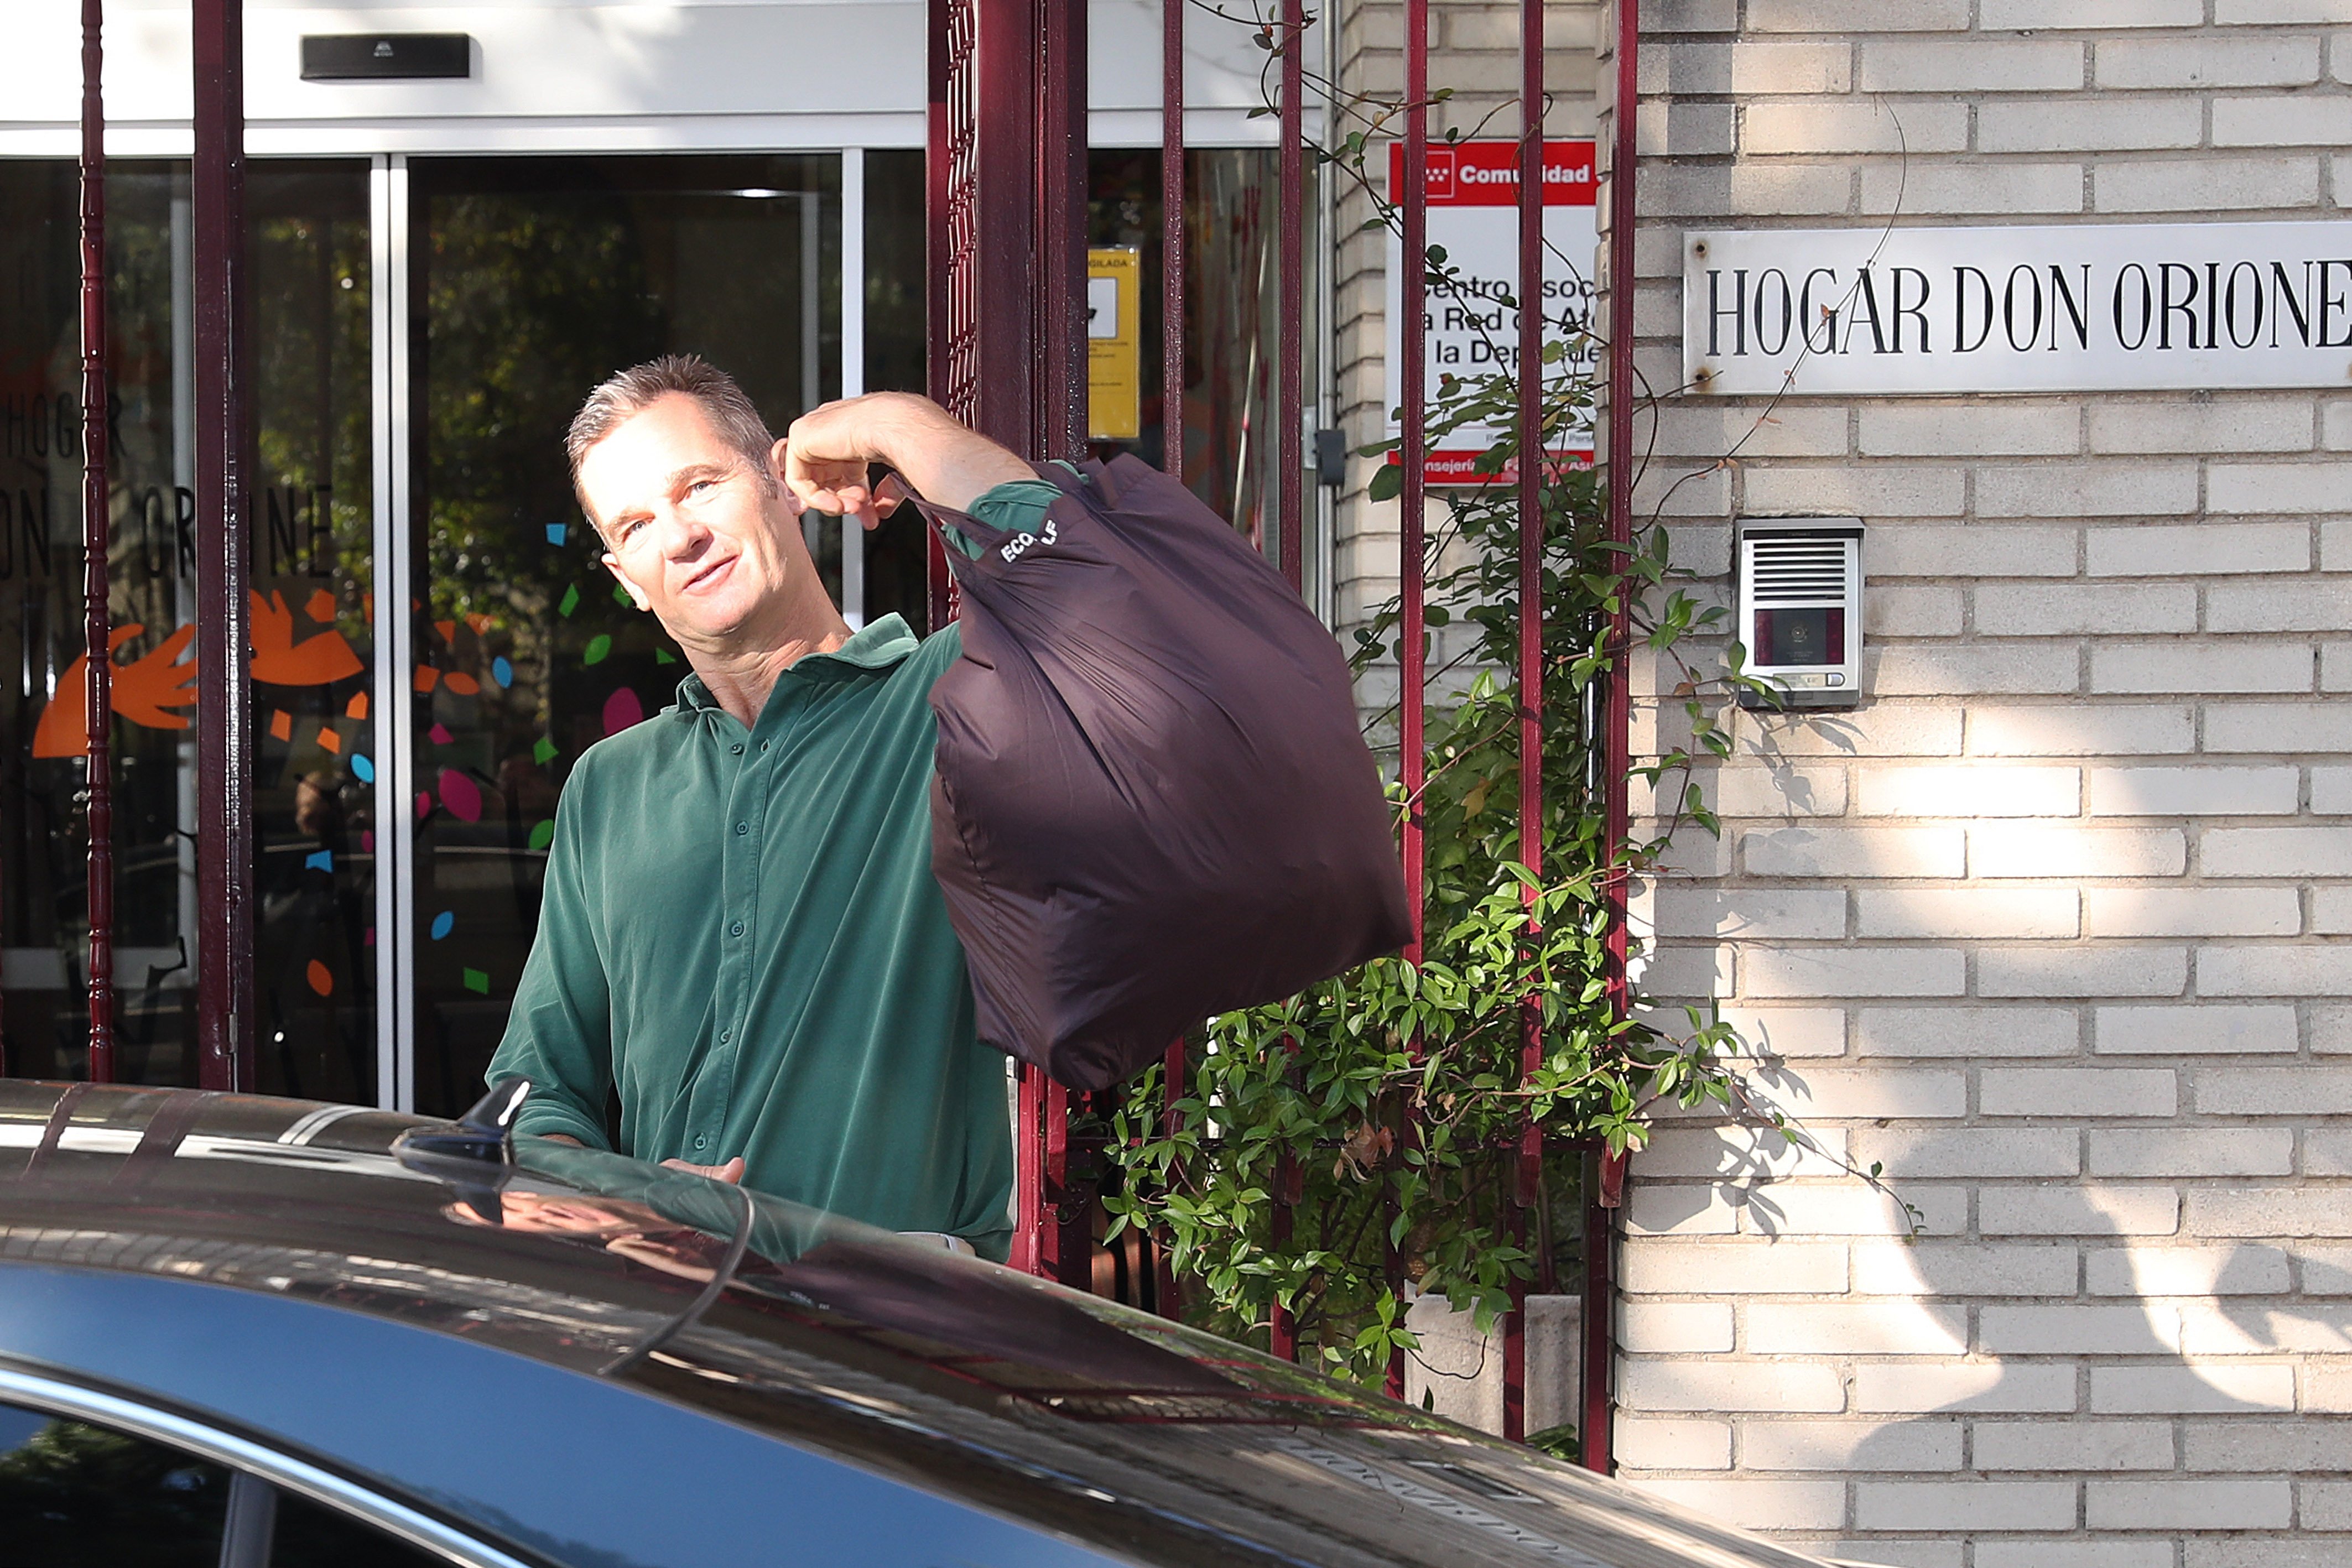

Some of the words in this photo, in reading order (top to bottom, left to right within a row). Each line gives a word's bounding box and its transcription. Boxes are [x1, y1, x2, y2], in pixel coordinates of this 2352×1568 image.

[1089, 258, 1127, 268] GILADA
[1425, 276, 1510, 299] entro
[1705, 268, 1933, 356] HOGAR
[1952, 264, 2091, 353] DON
[2113, 260, 2352, 351] ORIONE
[1436, 340, 1460, 363] la
[7, 392, 127, 459] HOGR
[143, 485, 332, 579] ORNE
[1000, 519, 1058, 563] ECOLF
